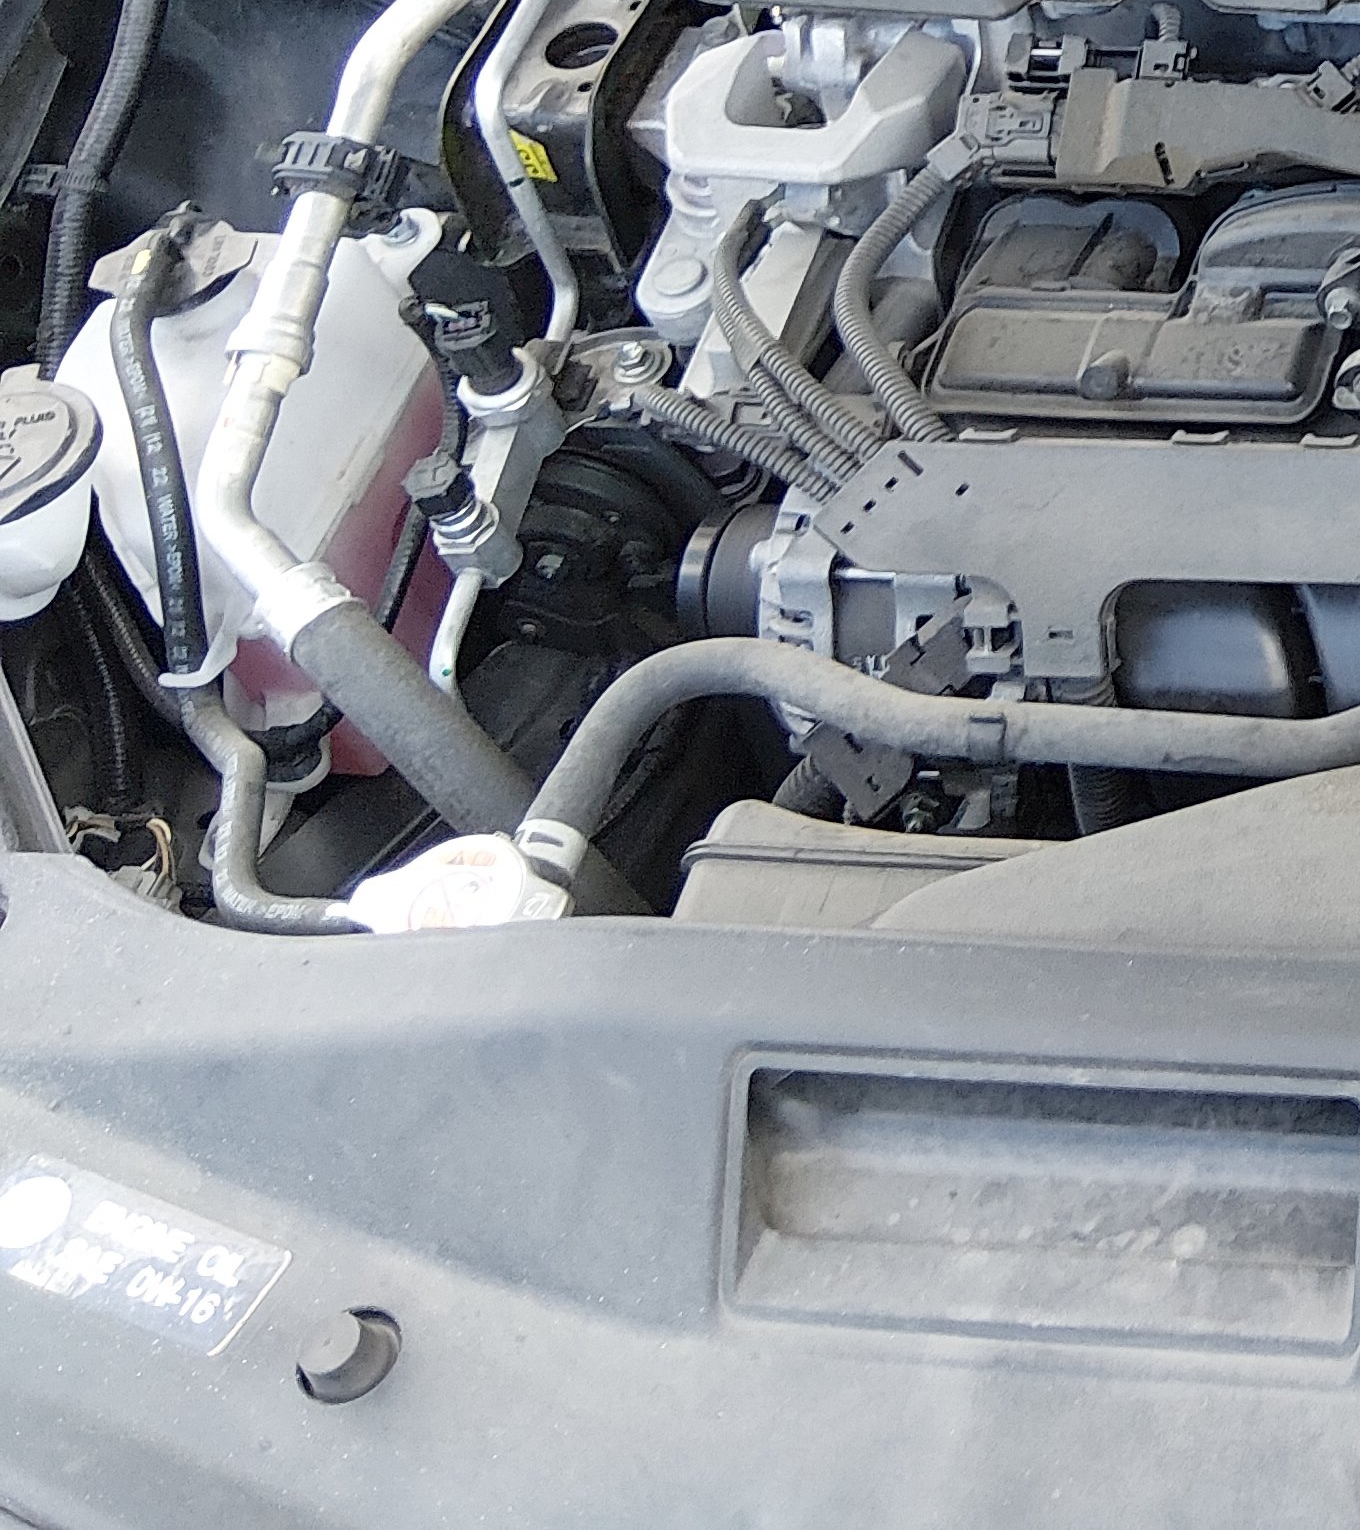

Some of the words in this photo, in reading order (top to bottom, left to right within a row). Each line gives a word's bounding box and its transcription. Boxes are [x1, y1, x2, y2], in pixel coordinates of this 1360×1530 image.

[156, 493, 178, 542] WATER
[84, 1200, 195, 1264] ENGINE
[197, 1245, 247, 1288] OIL
